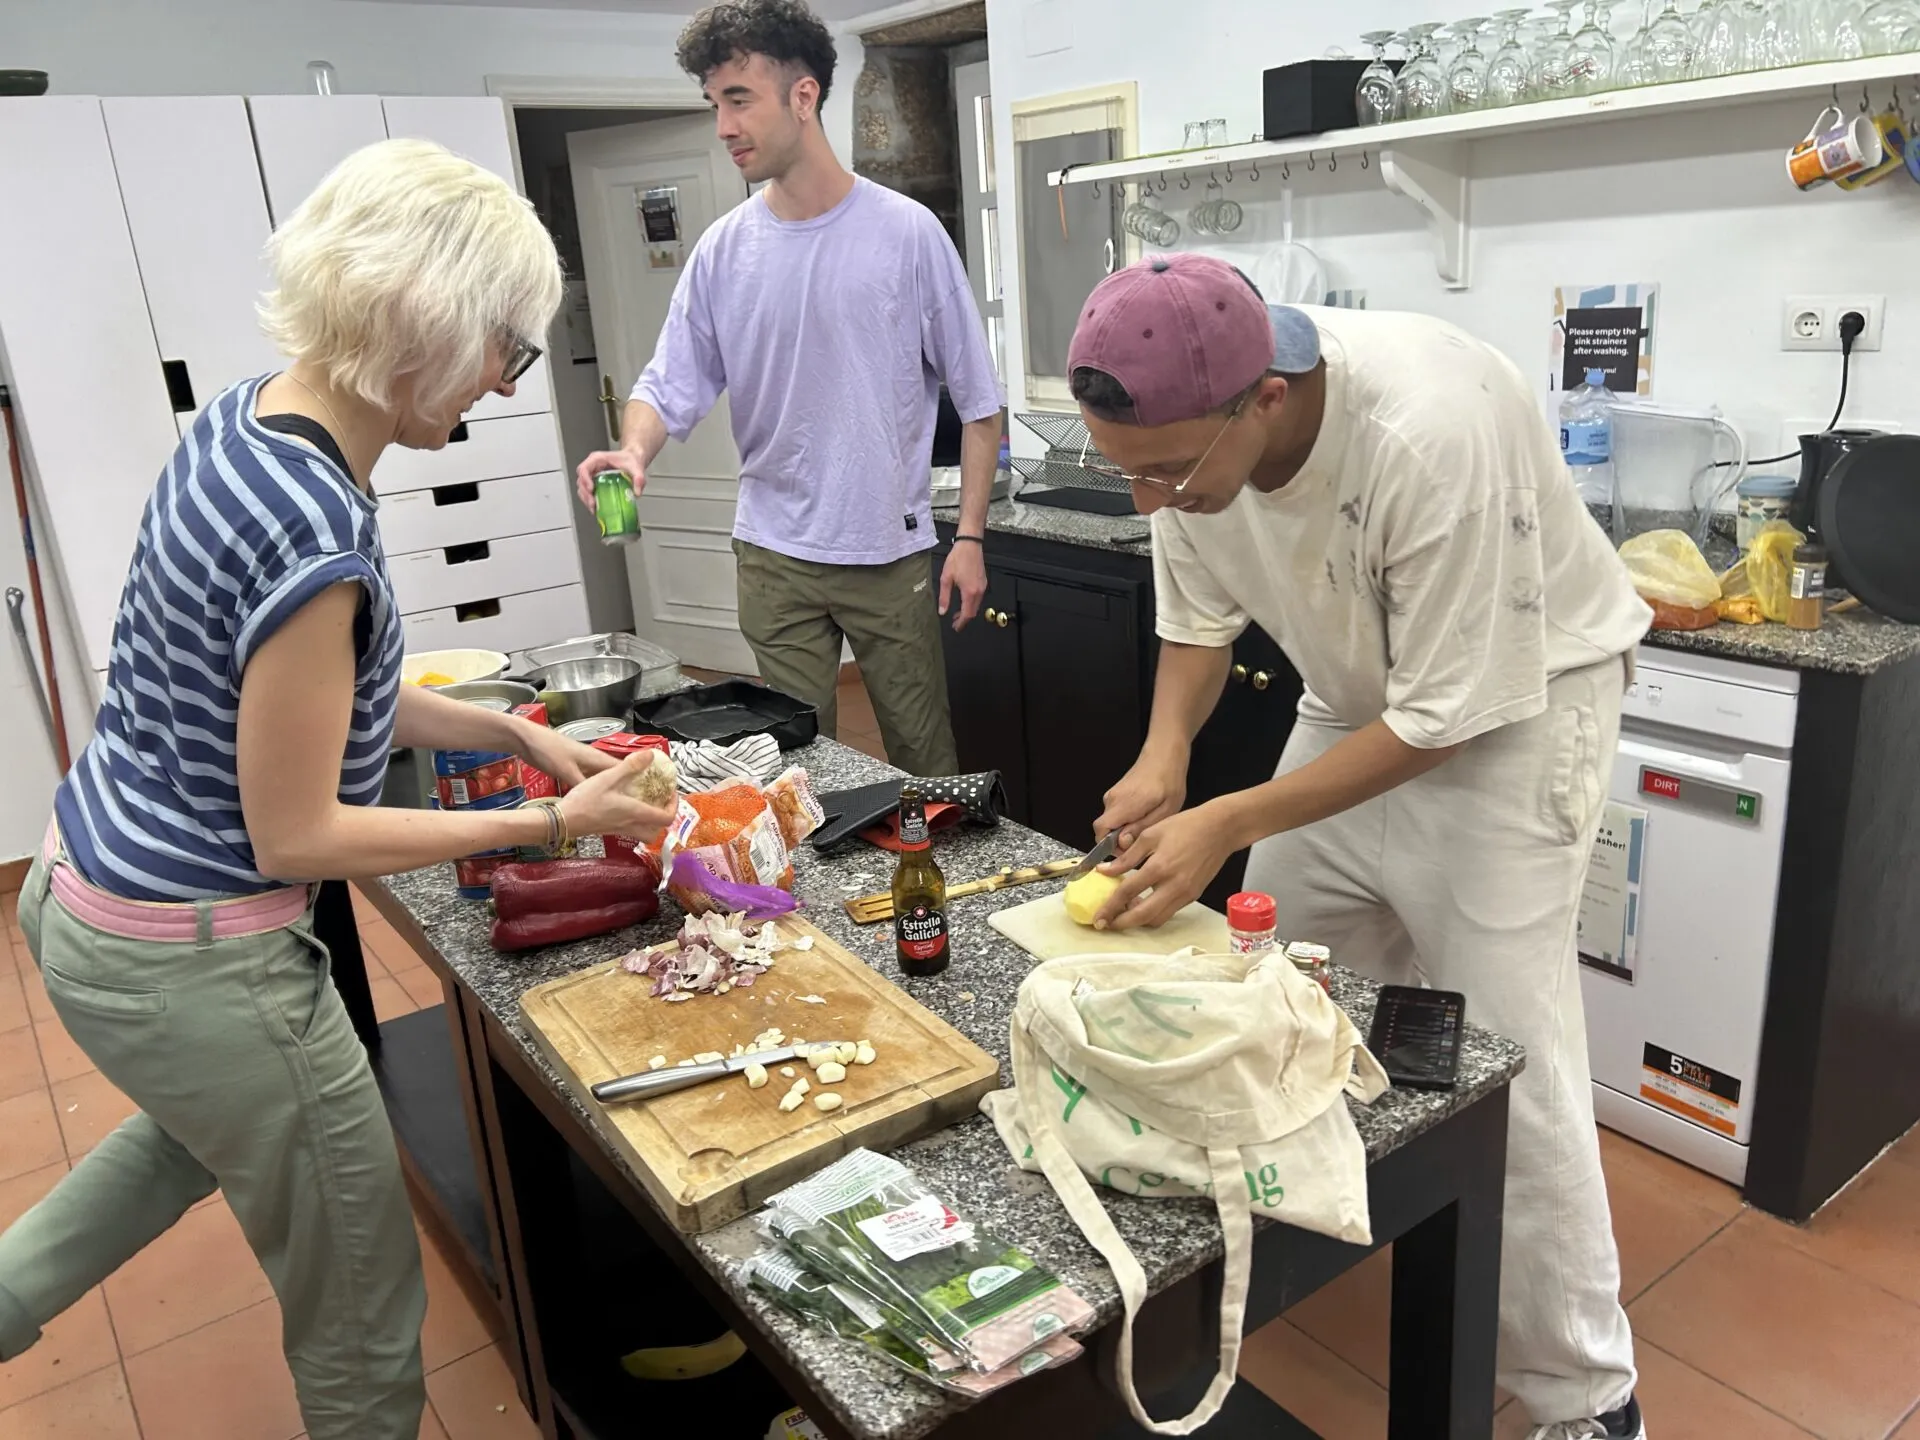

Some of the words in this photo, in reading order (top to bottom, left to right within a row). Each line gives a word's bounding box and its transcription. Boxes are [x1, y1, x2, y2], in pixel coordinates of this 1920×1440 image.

[1569, 328, 1594, 336] Please
[1595, 328, 1621, 338] empty
[1622, 327, 1637, 335] the
[1574, 337, 1591, 345] sink
[1592, 337, 1627, 345] strainers
[1573, 347, 1592, 355] after
[1593, 347, 1629, 356] washing.
[1654, 778, 1679, 793] DIRT
[902, 916, 941, 930] Estrella
[904, 927, 941, 941] Galicia
[1670, 1054, 1683, 1075] 5
